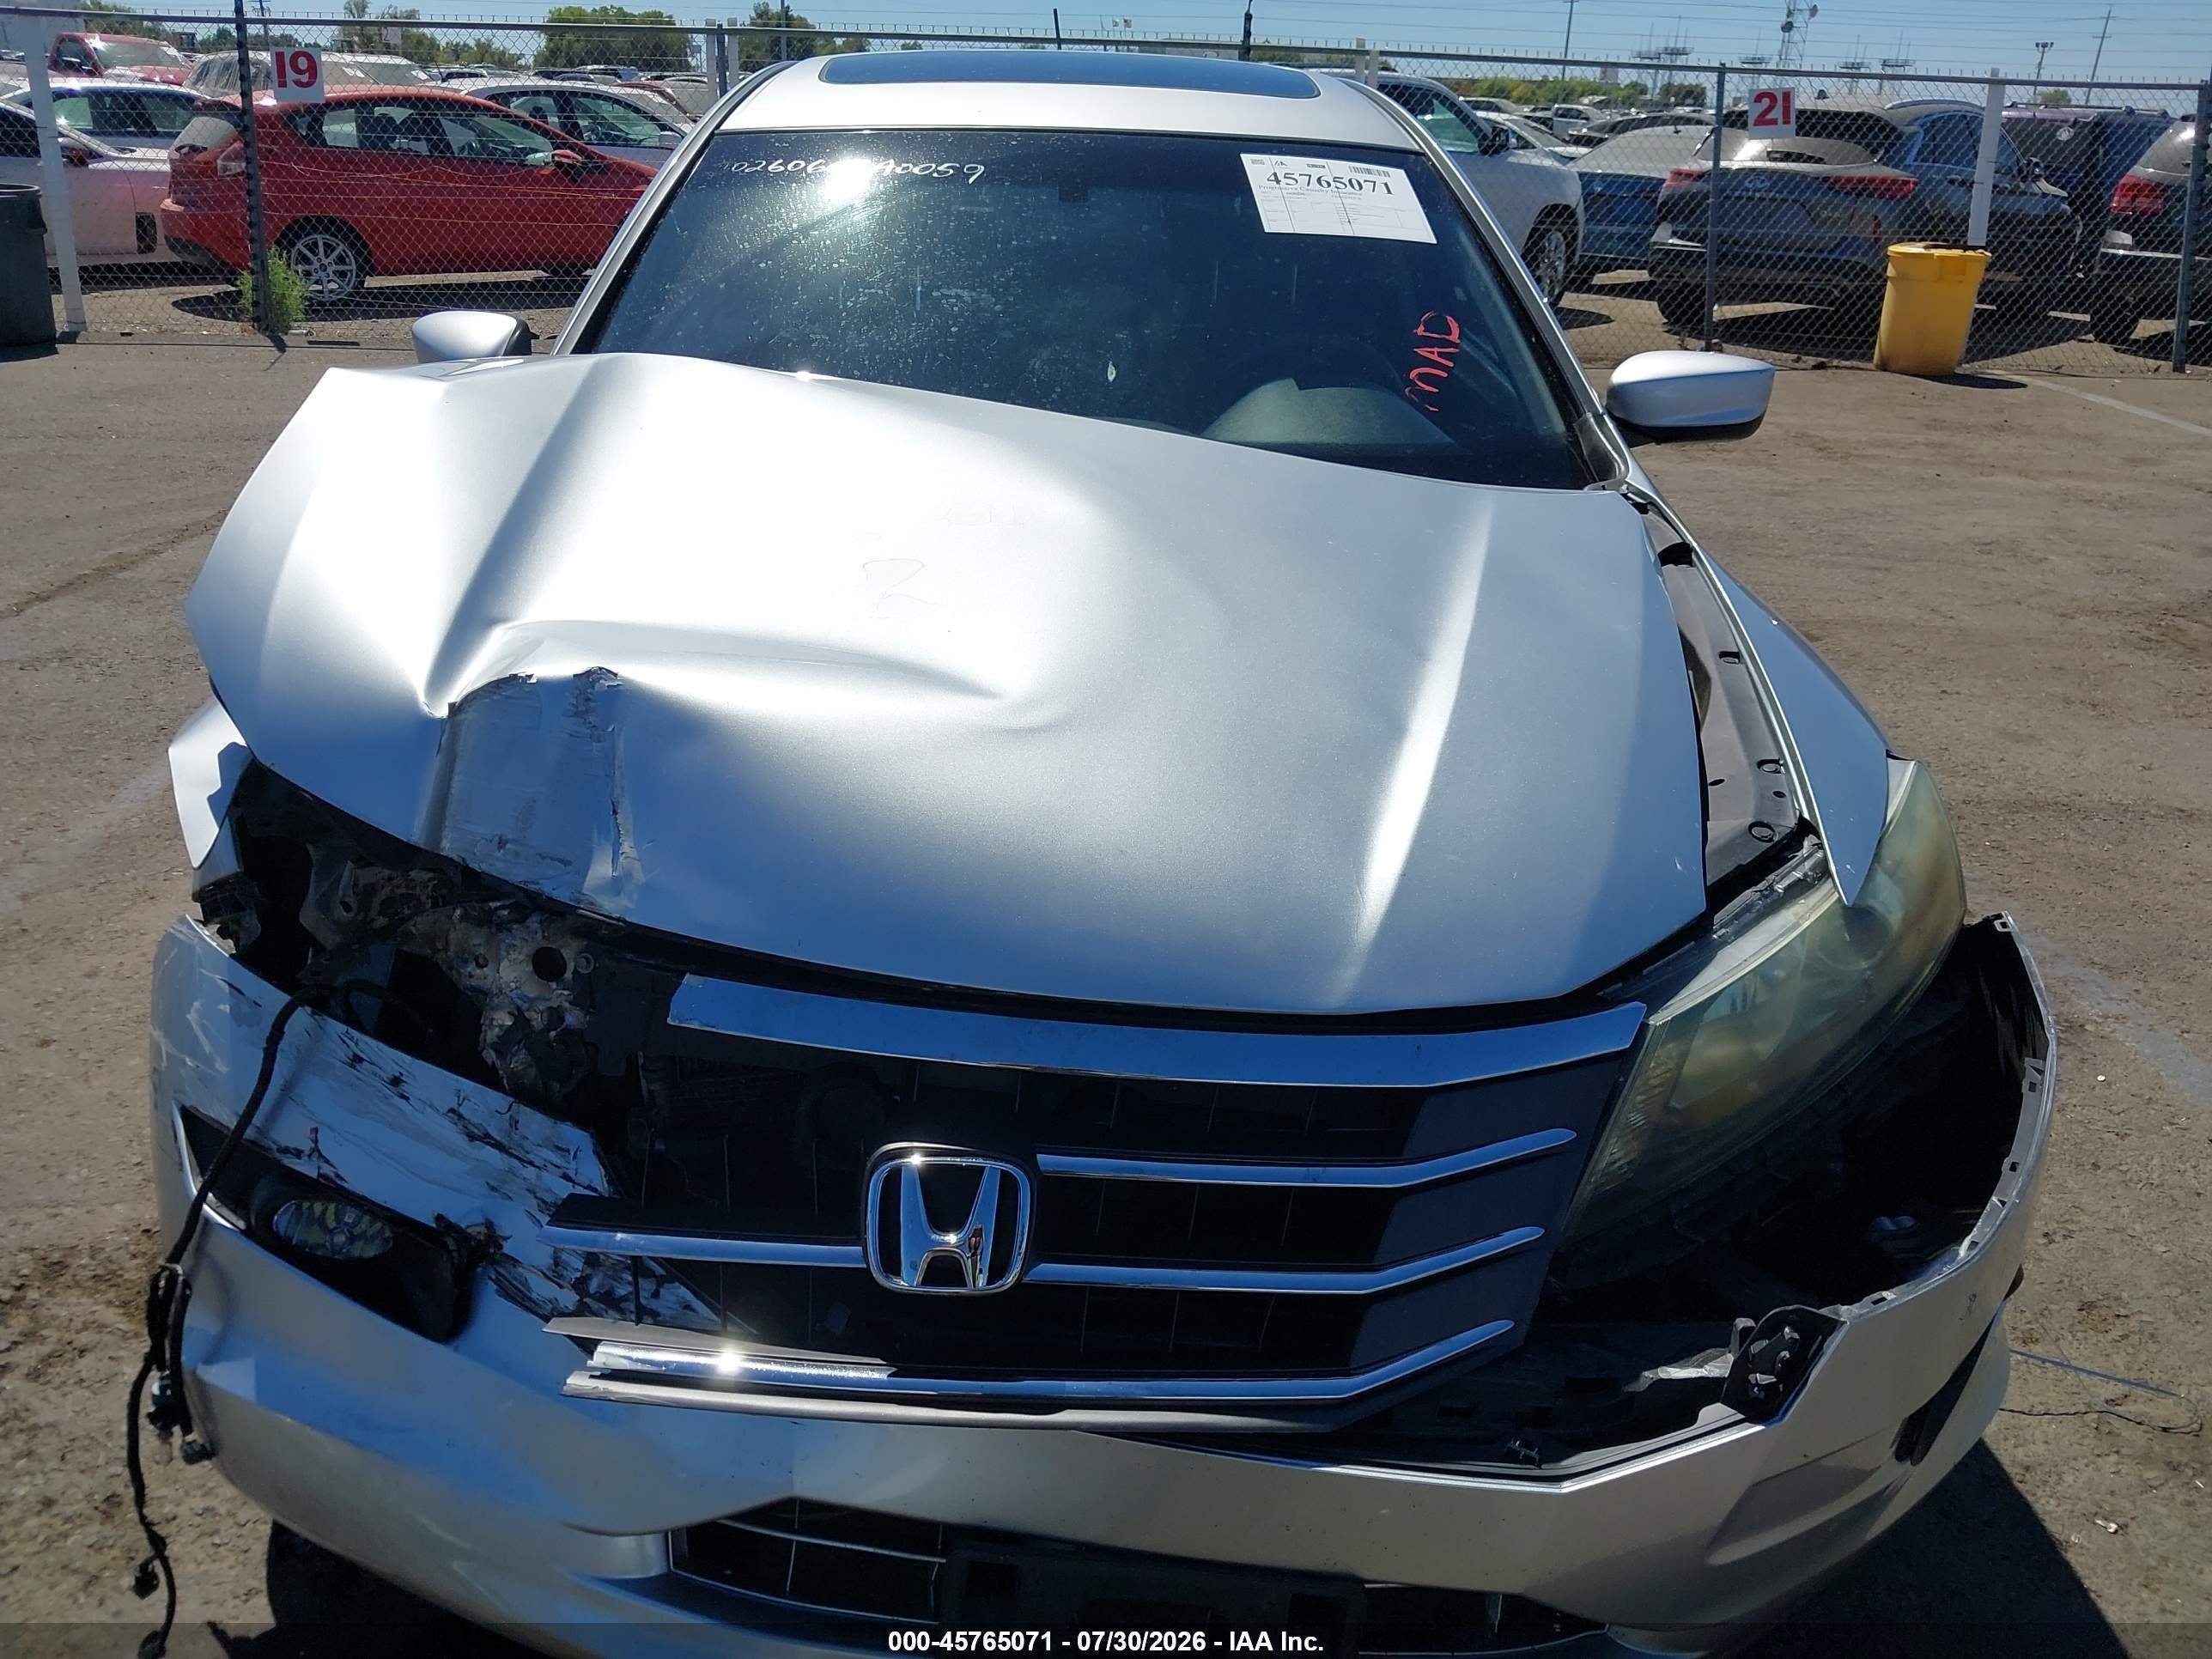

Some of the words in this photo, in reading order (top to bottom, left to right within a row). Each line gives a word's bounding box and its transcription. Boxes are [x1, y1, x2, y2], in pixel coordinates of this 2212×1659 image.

[275, 51, 317, 88] 19
[1753, 91, 1790, 126] 21
[1267, 171, 1395, 196] 45765071
